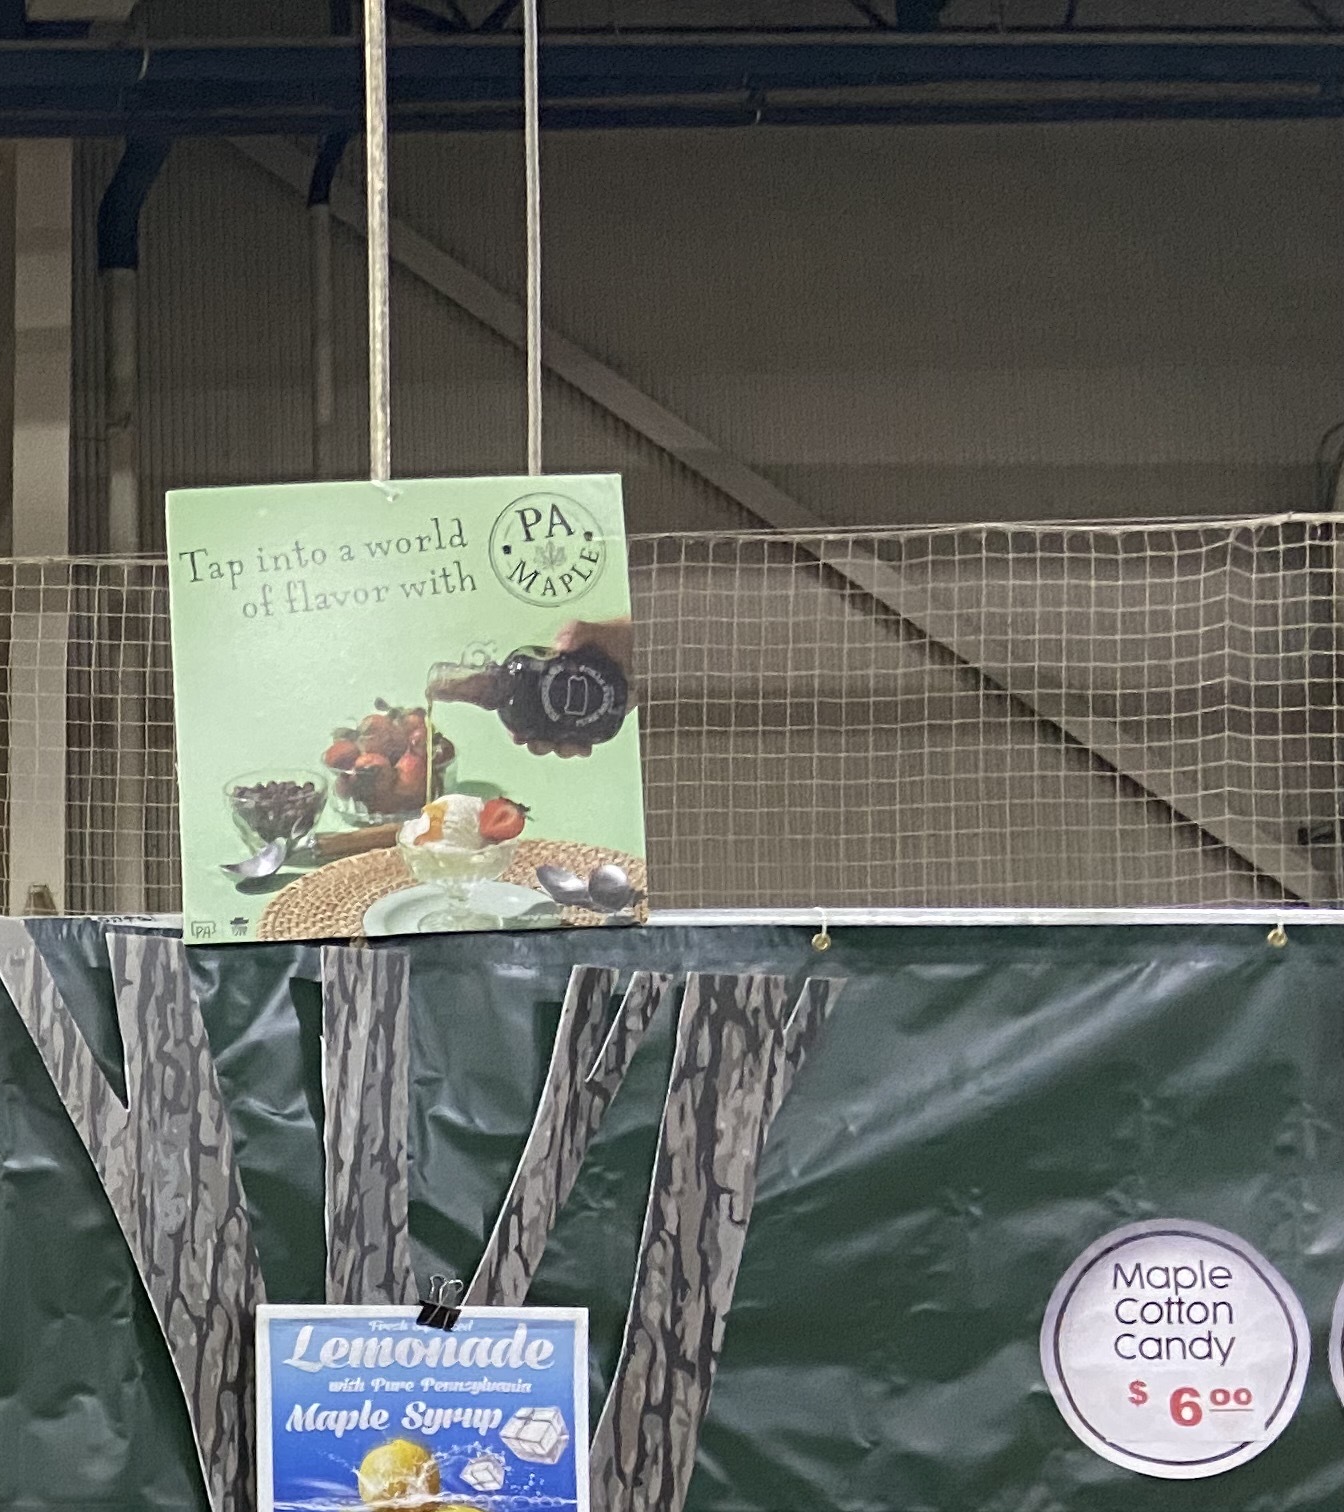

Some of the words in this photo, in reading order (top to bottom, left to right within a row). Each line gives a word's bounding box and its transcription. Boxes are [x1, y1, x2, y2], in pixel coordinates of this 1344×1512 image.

[515, 503, 575, 543] PA
[179, 549, 244, 590] Tap
[257, 541, 326, 574] into
[339, 544, 355, 563] a
[364, 518, 468, 559] world
[506, 545, 600, 597] MAPLE
[243, 585, 276, 619] of
[285, 578, 390, 613] flavor
[401, 561, 477, 600] with
[1112, 1260, 1232, 1296] Maple
[1114, 1298, 1234, 1325] Cotton
[284, 1324, 554, 1373] Lemonade
[1113, 1330, 1236, 1366] Candy
[329, 1378, 365, 1393] with
[371, 1378, 414, 1393] Pure
[421, 1377, 532, 1395] Pennsylvania
[286, 1401, 389, 1438] Maple
[401, 1401, 504, 1435] Syrup
